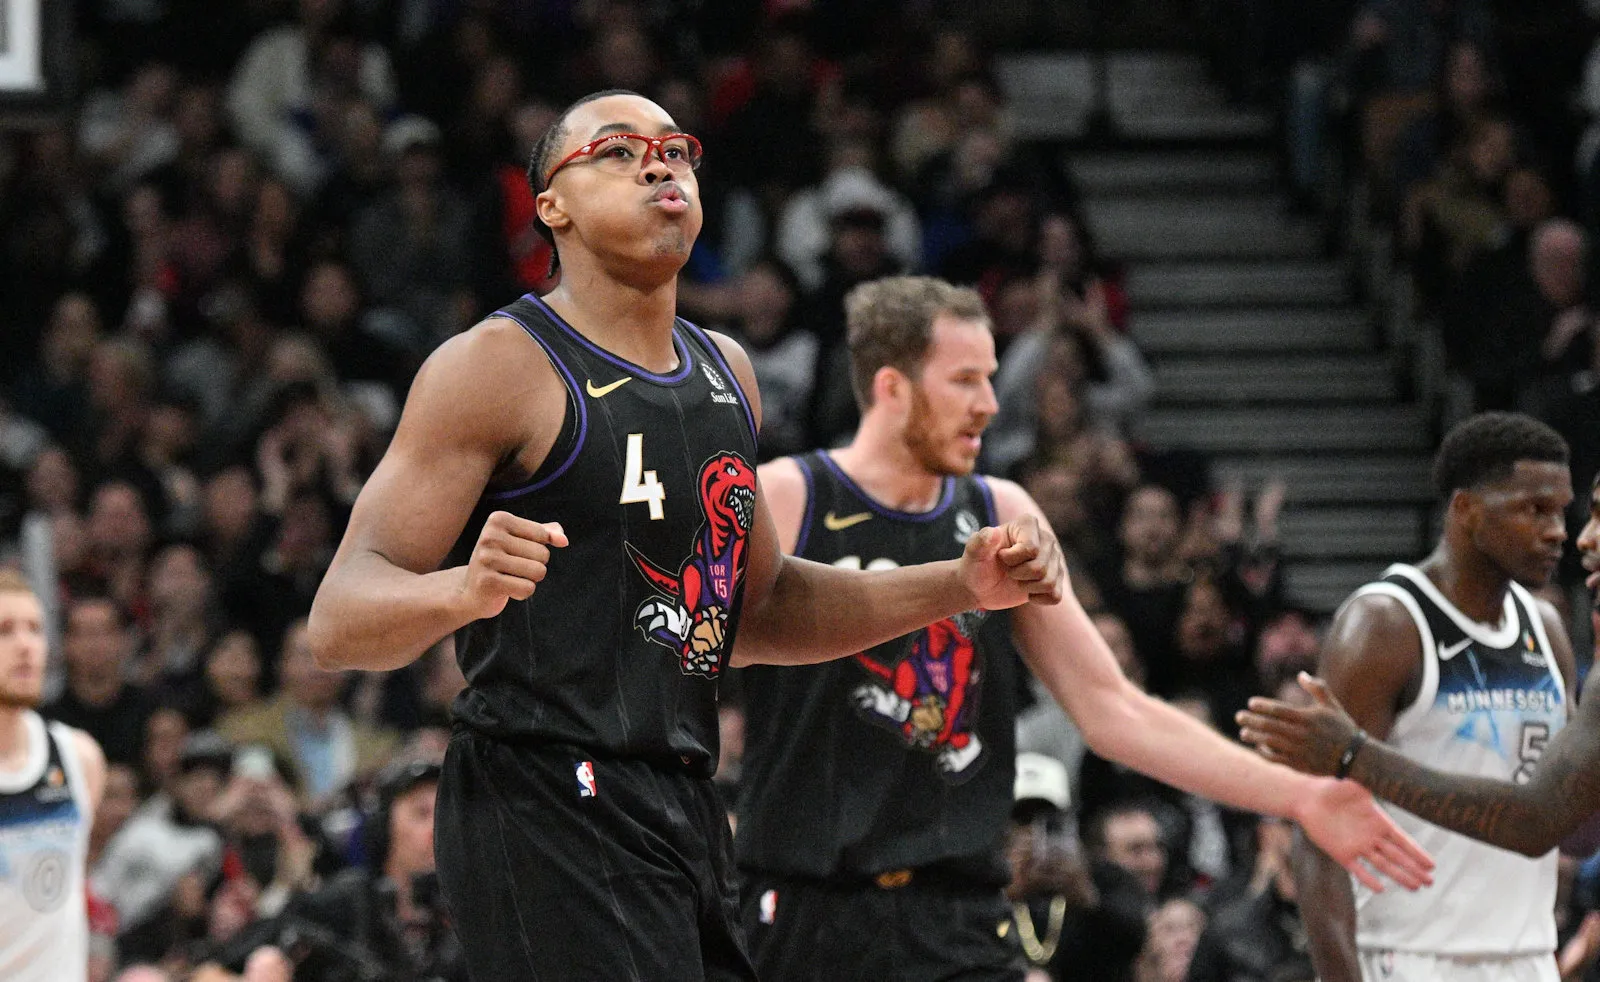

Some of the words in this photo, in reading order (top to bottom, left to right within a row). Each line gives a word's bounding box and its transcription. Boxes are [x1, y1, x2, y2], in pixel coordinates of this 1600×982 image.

[619, 433, 666, 521] 4
[709, 564, 726, 577] TOR
[714, 579, 728, 599] 15
[23, 848, 72, 914] 0
